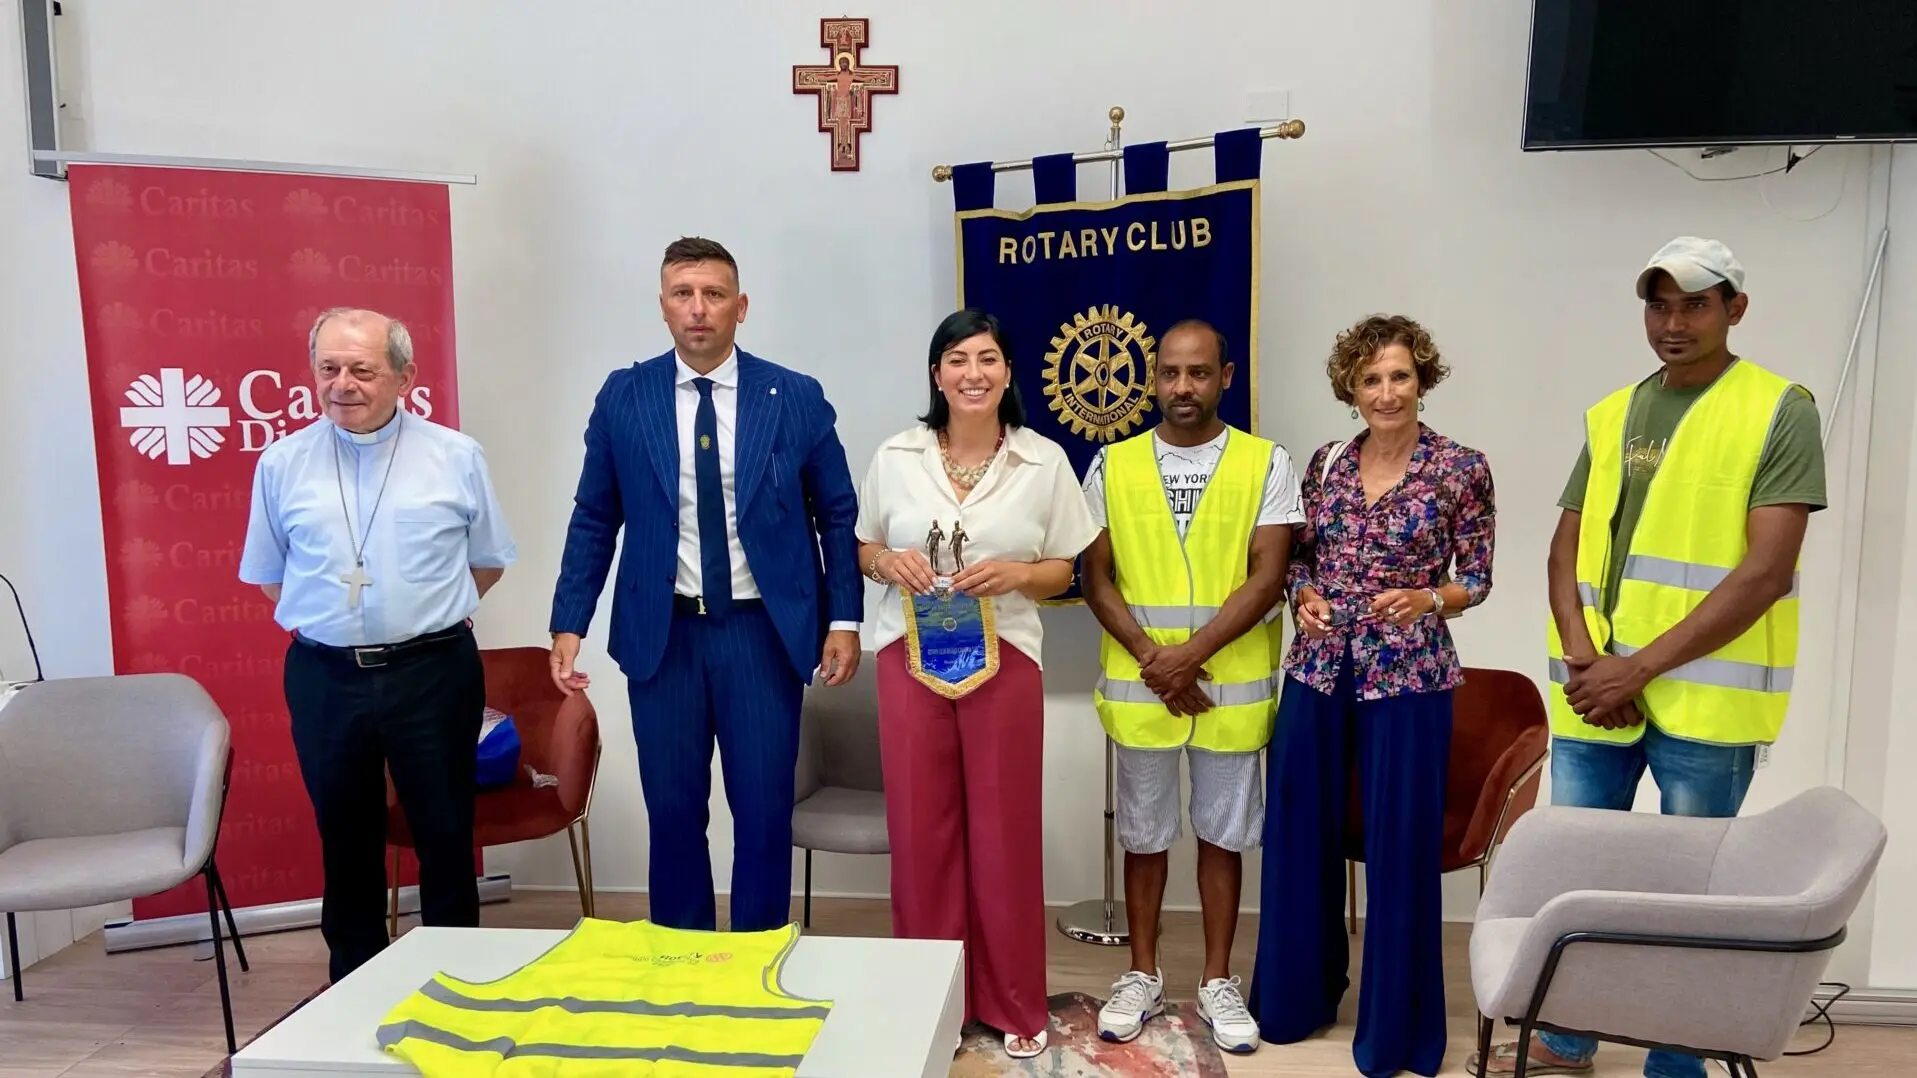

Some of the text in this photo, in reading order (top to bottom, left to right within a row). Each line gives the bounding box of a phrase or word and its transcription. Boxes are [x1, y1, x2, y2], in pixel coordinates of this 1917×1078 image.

[140, 186, 254, 218] Caritas
[333, 196, 439, 229] Caritas
[998, 217, 1212, 264] ROTARY CLUB
[145, 247, 258, 280] Caritas
[338, 254, 442, 286] Caritas
[150, 308, 263, 338] Caritas
[1083, 322, 1124, 339] ROTARY
[1064, 393, 1139, 425] INTERNATIONAL
[1163, 474, 1211, 484] EW YOR
[164, 483, 251, 511] Carit
[174, 597, 268, 624] Carita
